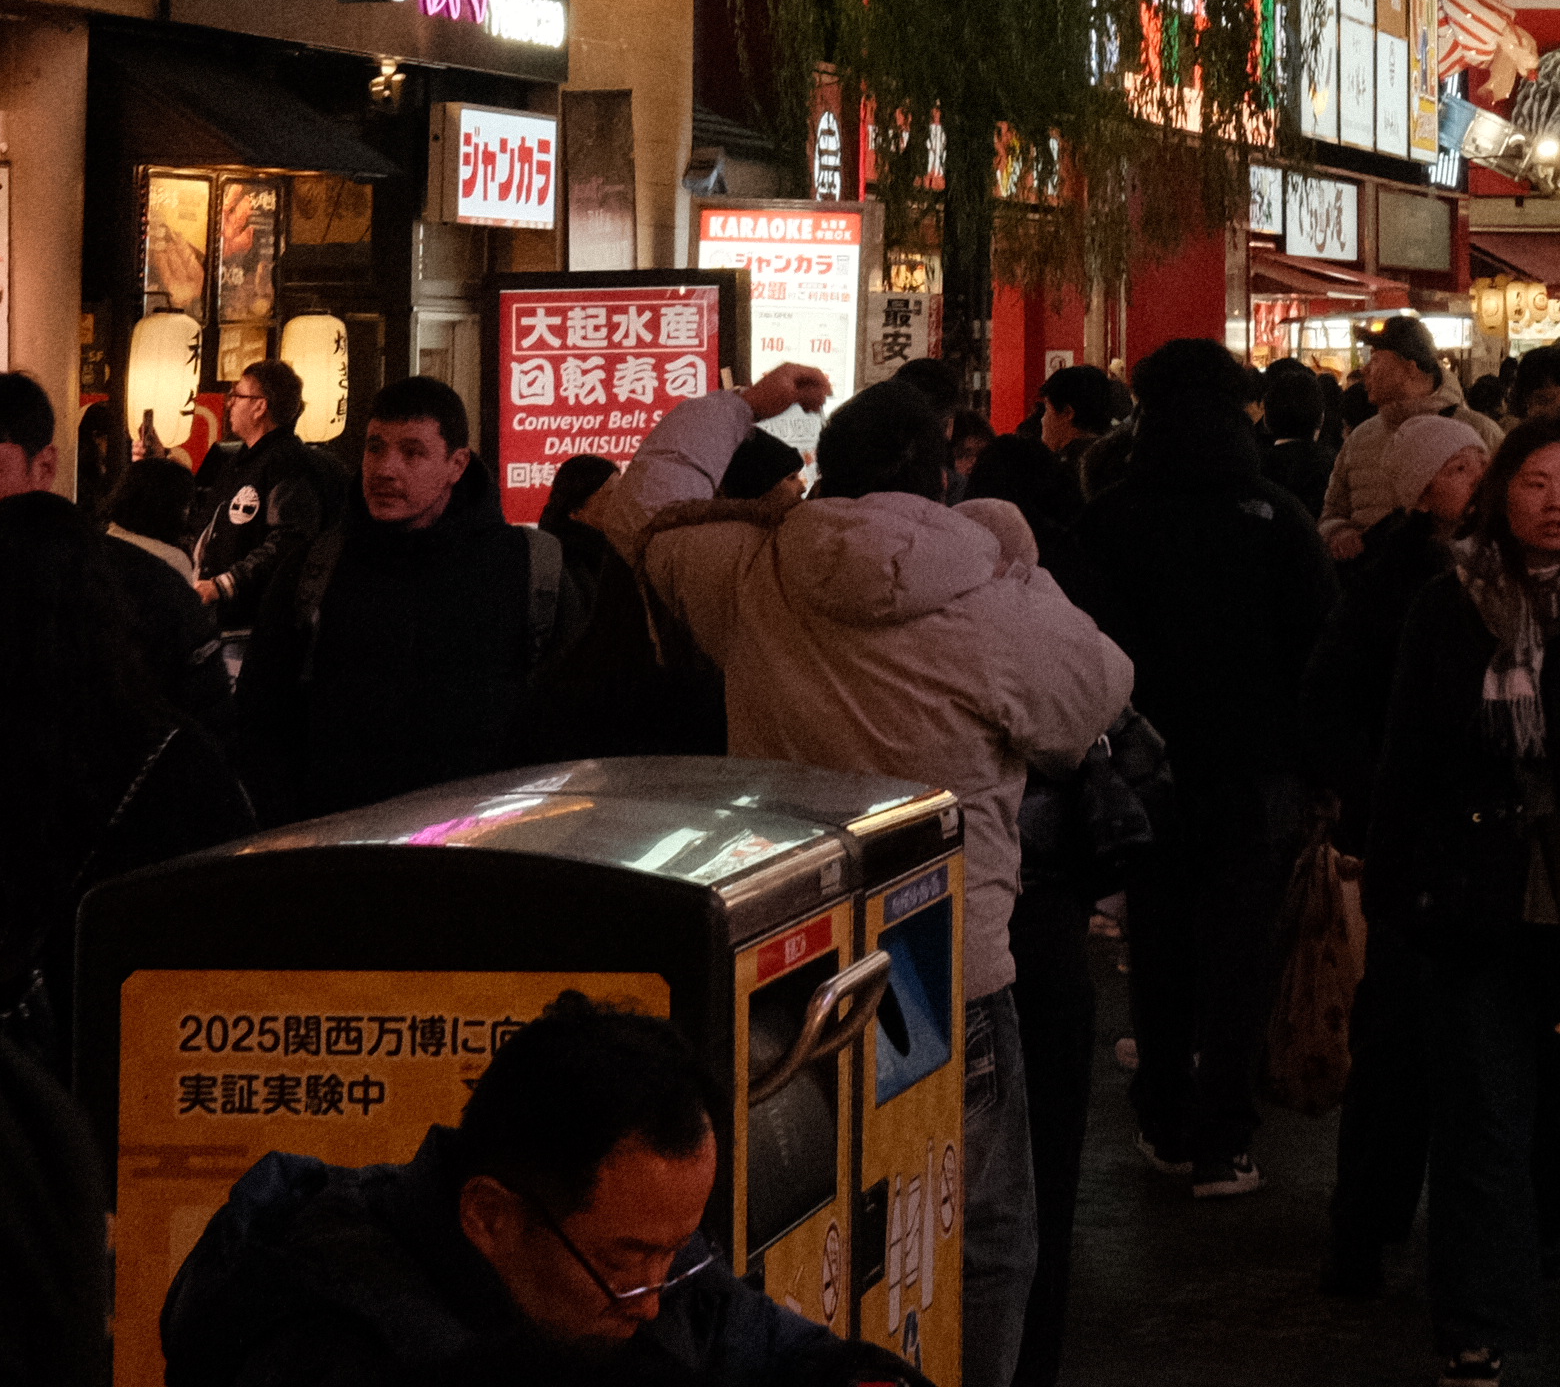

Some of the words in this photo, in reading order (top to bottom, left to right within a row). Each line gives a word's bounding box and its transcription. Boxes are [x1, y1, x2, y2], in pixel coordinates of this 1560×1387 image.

[460, 126, 551, 206] ジャンカラ
[708, 215, 814, 241] KARAOKE
[735, 250, 834, 275] ジャンカラ
[519, 305, 701, 350] 大起水産
[760, 336, 785, 353] 140
[809, 337, 832, 354] 170
[509, 354, 708, 407] 回転寿司
[512, 412, 604, 432] Conveyor
[608, 410, 638, 429] Belt
[544, 435, 642, 456] DAIKISUIS
[177, 1073, 387, 1116] 実証実験中
